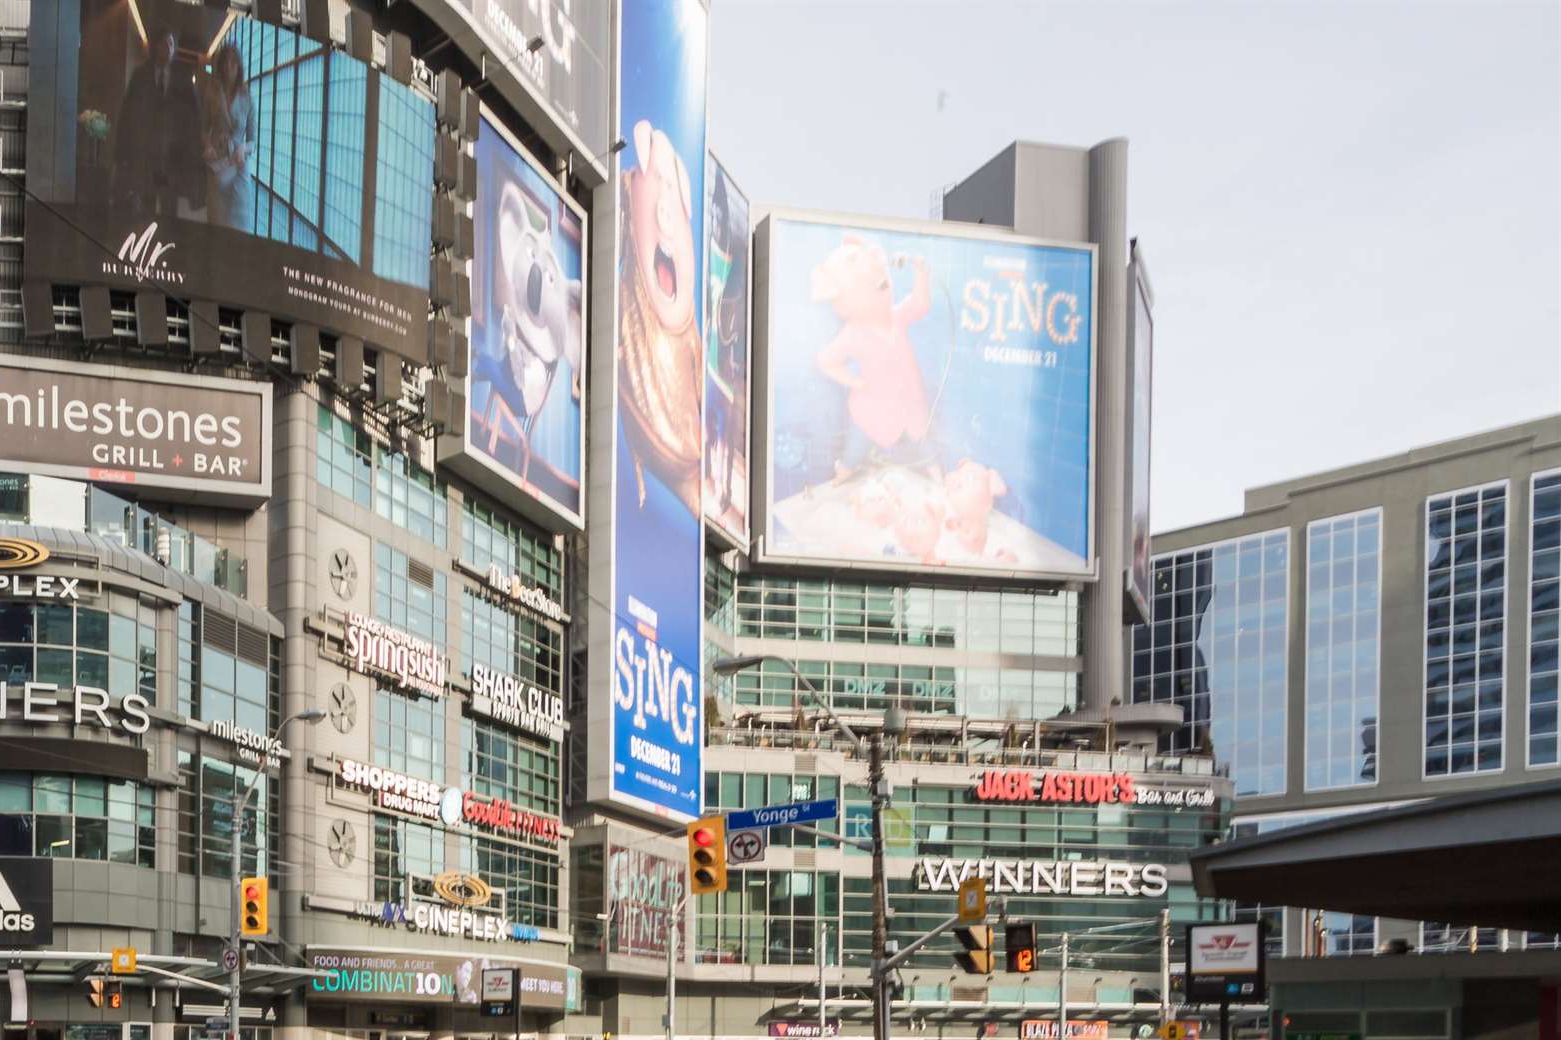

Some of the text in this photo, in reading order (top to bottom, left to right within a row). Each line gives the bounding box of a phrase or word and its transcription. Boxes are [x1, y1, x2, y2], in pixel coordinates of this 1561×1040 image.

[117, 222, 176, 282] Mr.
[283, 266, 412, 323] THE NEW FRAGRANCE FOR MEN
[288, 286, 328, 304] MONOGRAM
[330, 299, 351, 314] YOURS
[353, 306, 361, 317] AT
[961, 278, 1084, 346] SING
[92, 443, 165, 469] GRILL
[489, 561, 511, 593] The
[472, 664, 526, 712] SHARK
[527, 688, 564, 724] CLUB
[615, 627, 697, 746] SING
[844, 679, 886, 695] DMZ
[912, 682, 955, 698] DMZ
[213, 719, 282, 756] milestones
[630, 735, 672, 772] DECEMBER
[239, 747, 280, 768] GRILL BAR
[342, 759, 440, 805] SHOPPERS
[977, 770, 1035, 800] JACK
[1041, 771, 1135, 805] ASTOR'S
[1137, 787, 1162, 805] Bar
[1164, 789, 1183, 805] and
[384, 792, 439, 818] DRUG MART
[753, 805, 799, 824] Yonge
[921, 859, 1168, 898] WINNERS
[415, 906, 508, 940] CINEPLEX
[314, 954, 339, 967] FOOD
[341, 956, 360, 968] AND
[787, 1023, 835, 1037] wine rck
